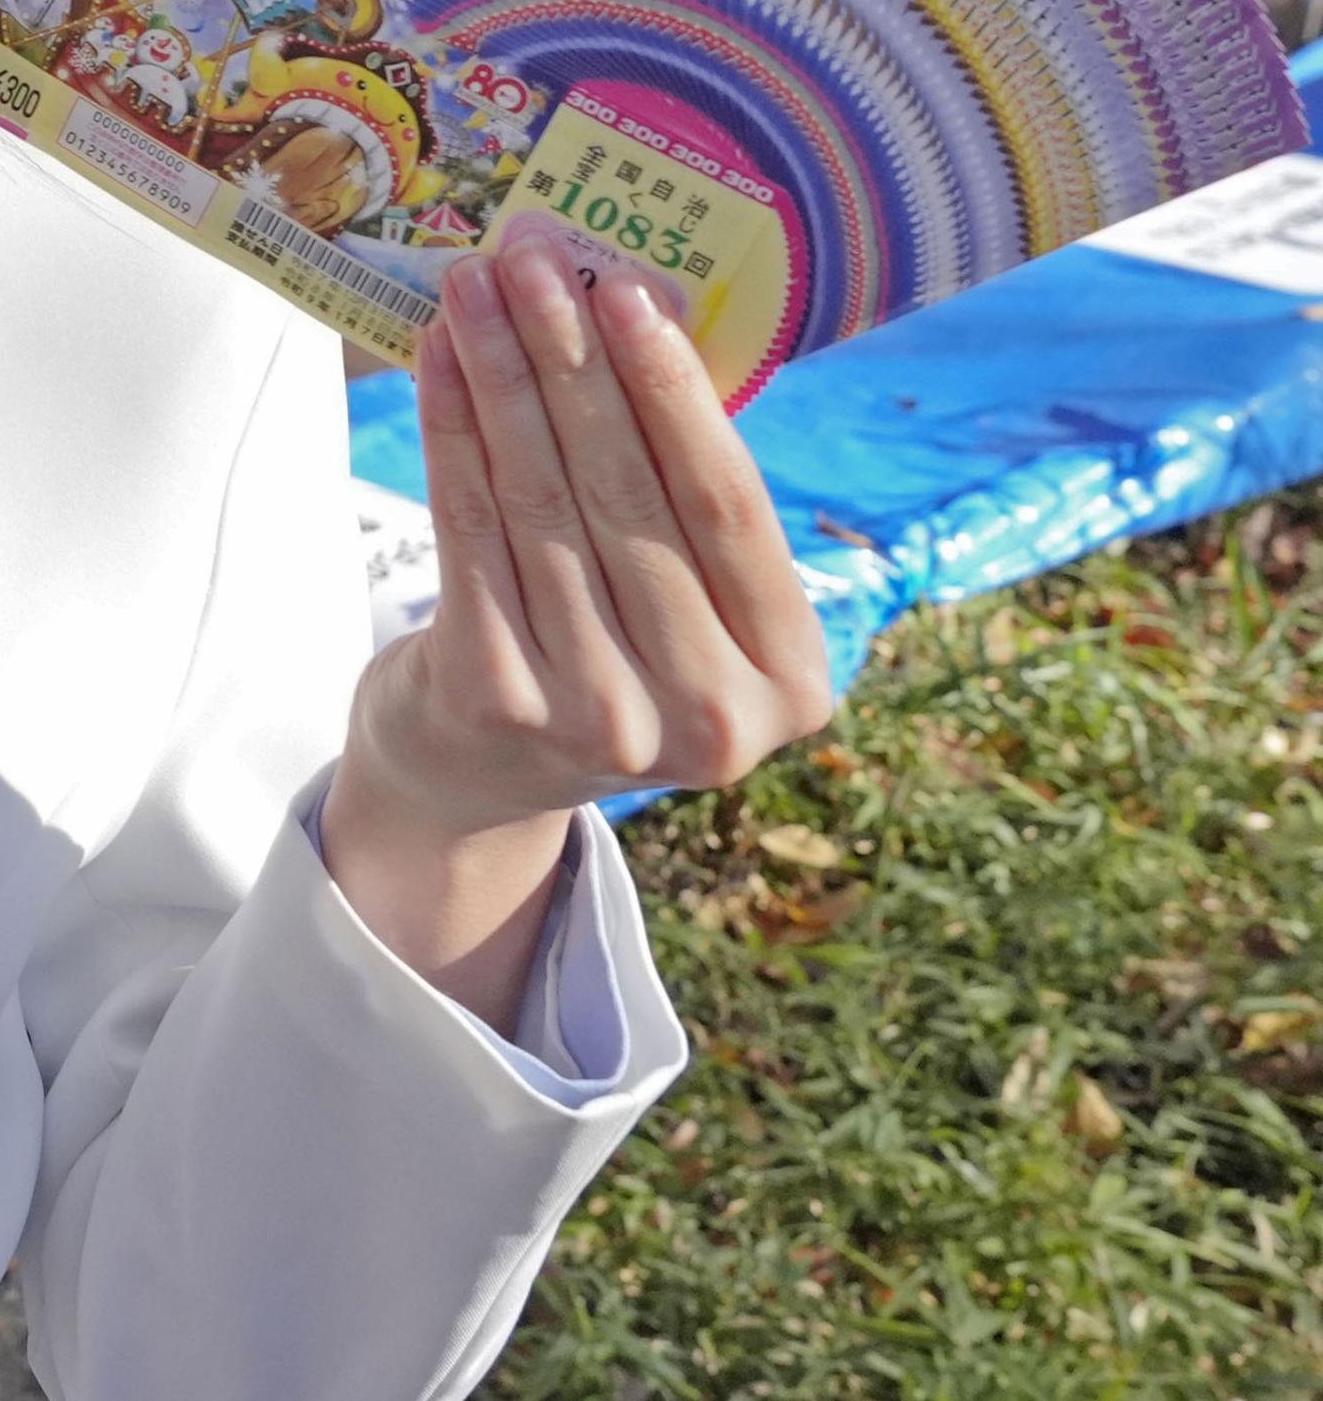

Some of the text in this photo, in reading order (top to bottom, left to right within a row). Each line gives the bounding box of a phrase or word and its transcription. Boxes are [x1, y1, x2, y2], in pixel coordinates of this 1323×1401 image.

[464, 64, 528, 114] 80
[65, 131, 192, 215] 012345678909
[93, 110, 186, 174] 0000000000
[565, 90, 617, 126] 300
[618, 116, 670, 151] 300
[669, 143, 722, 178] 300
[721, 171, 775, 204] 300
[587, 143, 710, 221] 全国自治
[526, 169, 715, 280] 第1083回
